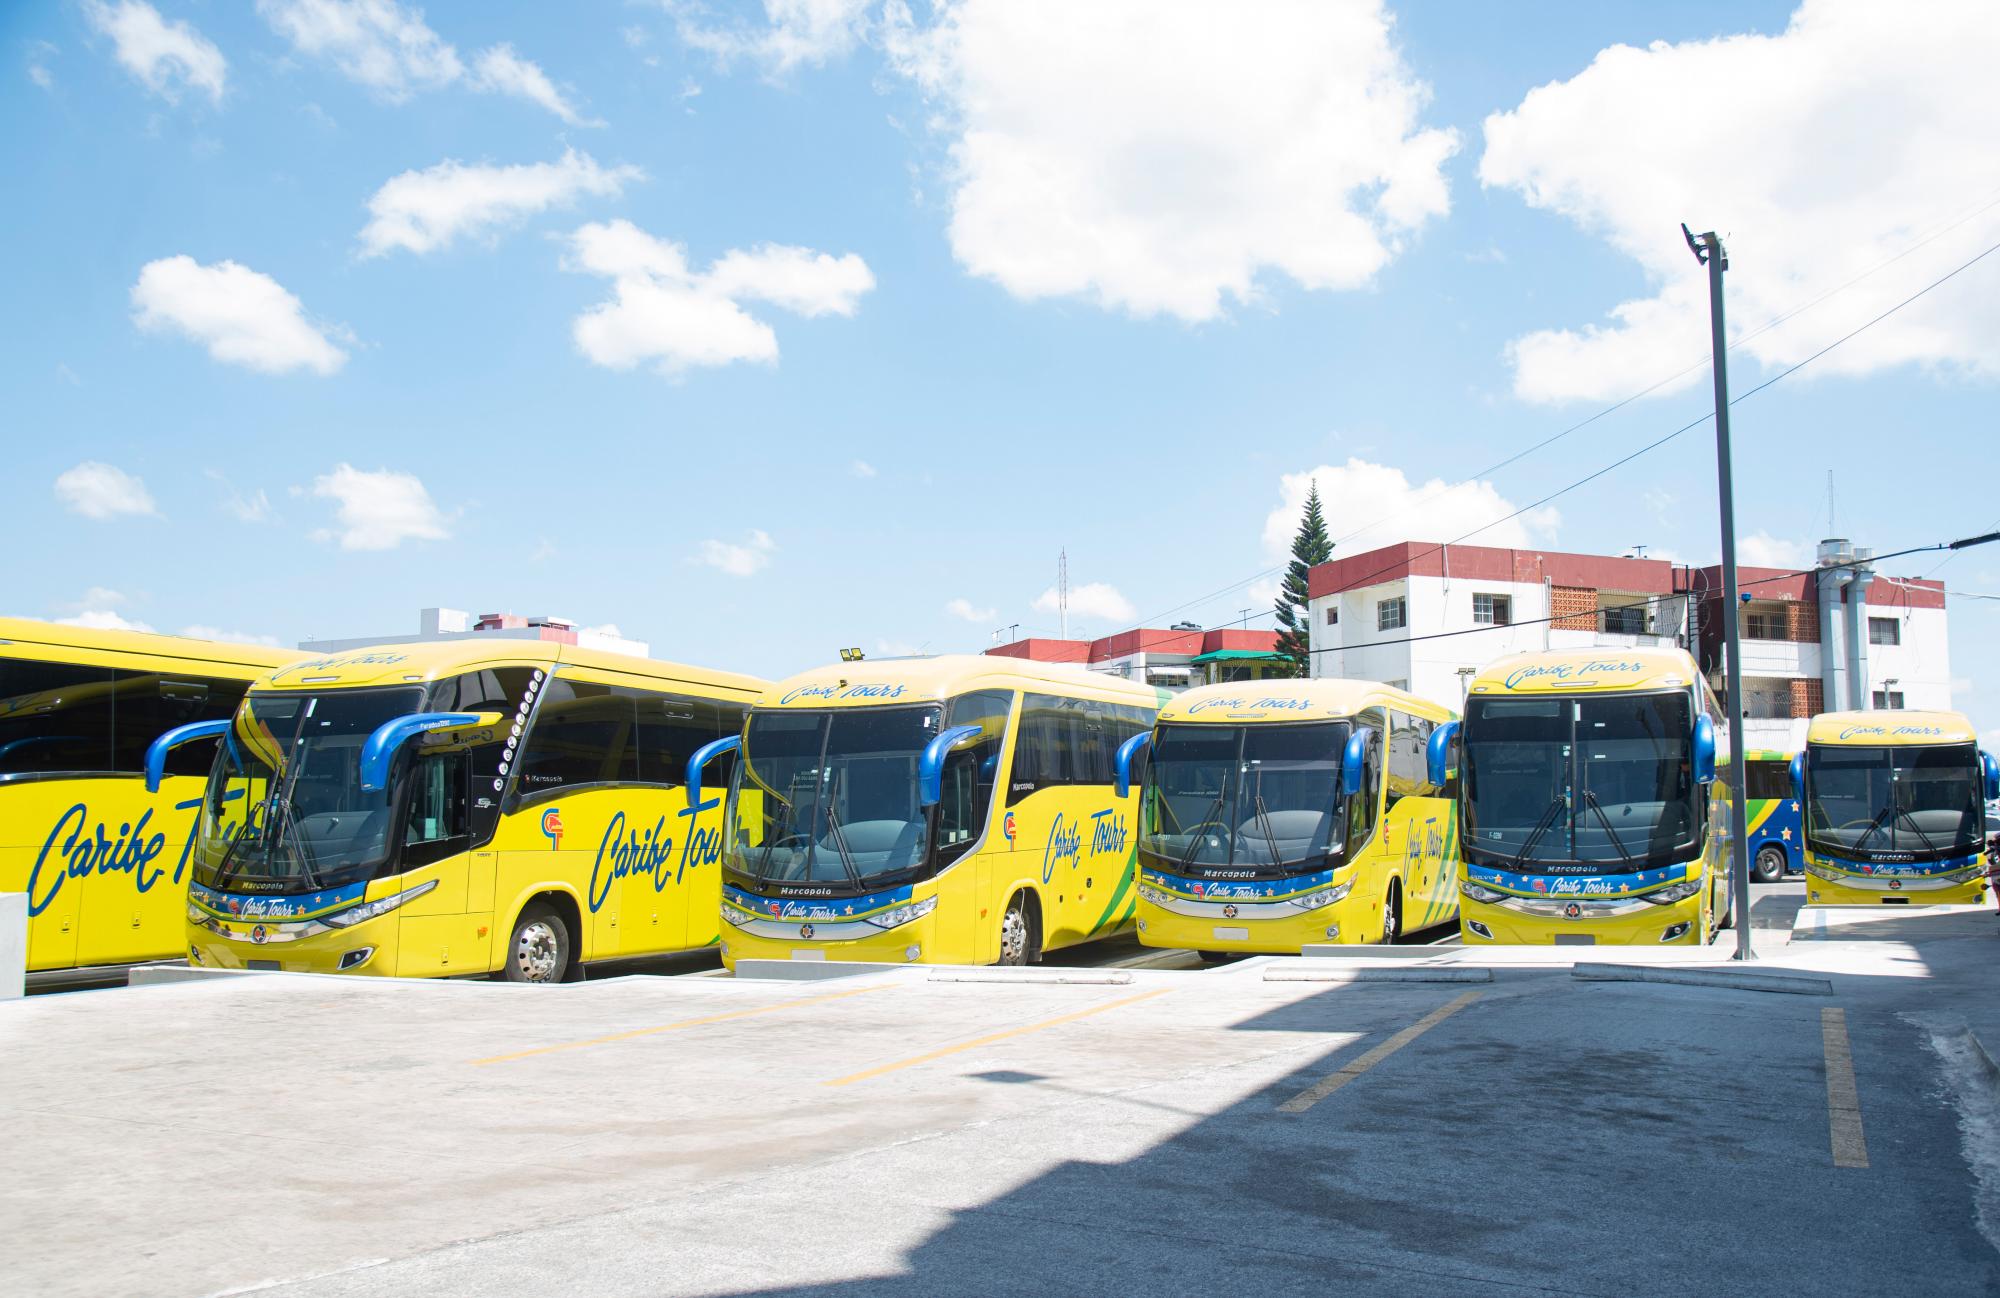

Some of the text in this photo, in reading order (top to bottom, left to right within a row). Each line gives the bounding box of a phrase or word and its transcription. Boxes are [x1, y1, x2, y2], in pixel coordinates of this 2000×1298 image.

[1505, 659, 1648, 689] Caribe Tours
[840, 683, 908, 699] Tours
[1188, 696, 1314, 714] Caribe Tours
[1891, 725, 1943, 735] Tours
[589, 797, 722, 913] Caribe Tou
[1043, 808, 1127, 884] Caribe Tours
[27, 803, 165, 917] Caribe
[1547, 865, 1598, 873] Marcopolo
[1203, 869, 1256, 878] Marcopolo
[242, 881, 284, 890] Marcopolo
[780, 887, 832, 895] Marcopolo
[1205, 882, 1263, 900] Caribe Tours
[1549, 877, 1614, 898] Caribe Tours
[240, 897, 294, 920] Caribe Tours
[782, 901, 838, 921] Caribe Tours
